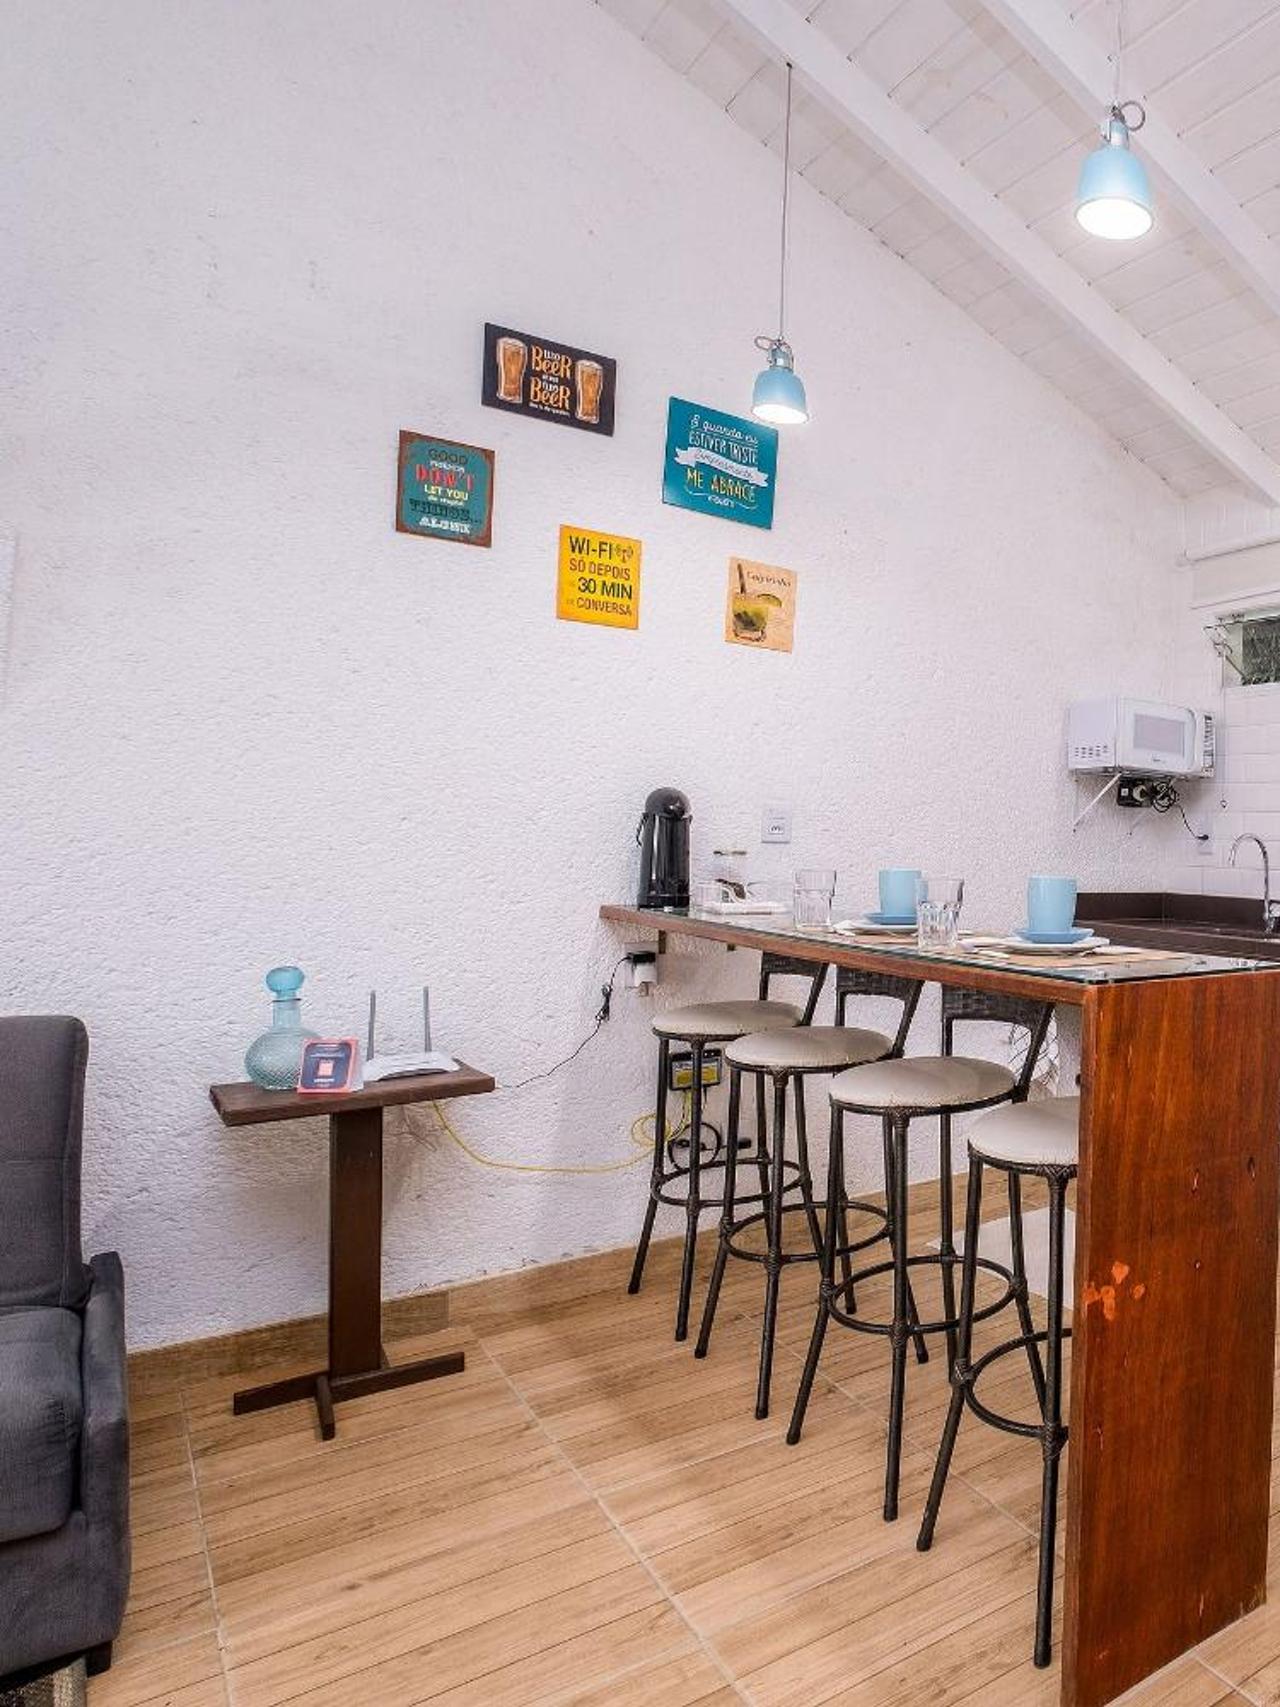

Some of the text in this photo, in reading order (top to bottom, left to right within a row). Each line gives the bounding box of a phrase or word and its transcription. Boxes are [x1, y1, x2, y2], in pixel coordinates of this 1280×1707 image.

[428, 448, 467, 464] GOOD
[689, 431, 758, 465] ESTIVER TRISTE
[424, 484, 469, 500] LET YOU
[687, 468, 703, 488] ME
[711, 475, 755, 503] ABRACE
[570, 535, 612, 560] WI-FI
[588, 561, 631, 581] DEPOIS
[578, 576, 632, 600] 30 MIN
[577, 597, 632, 616] CONVERSA
